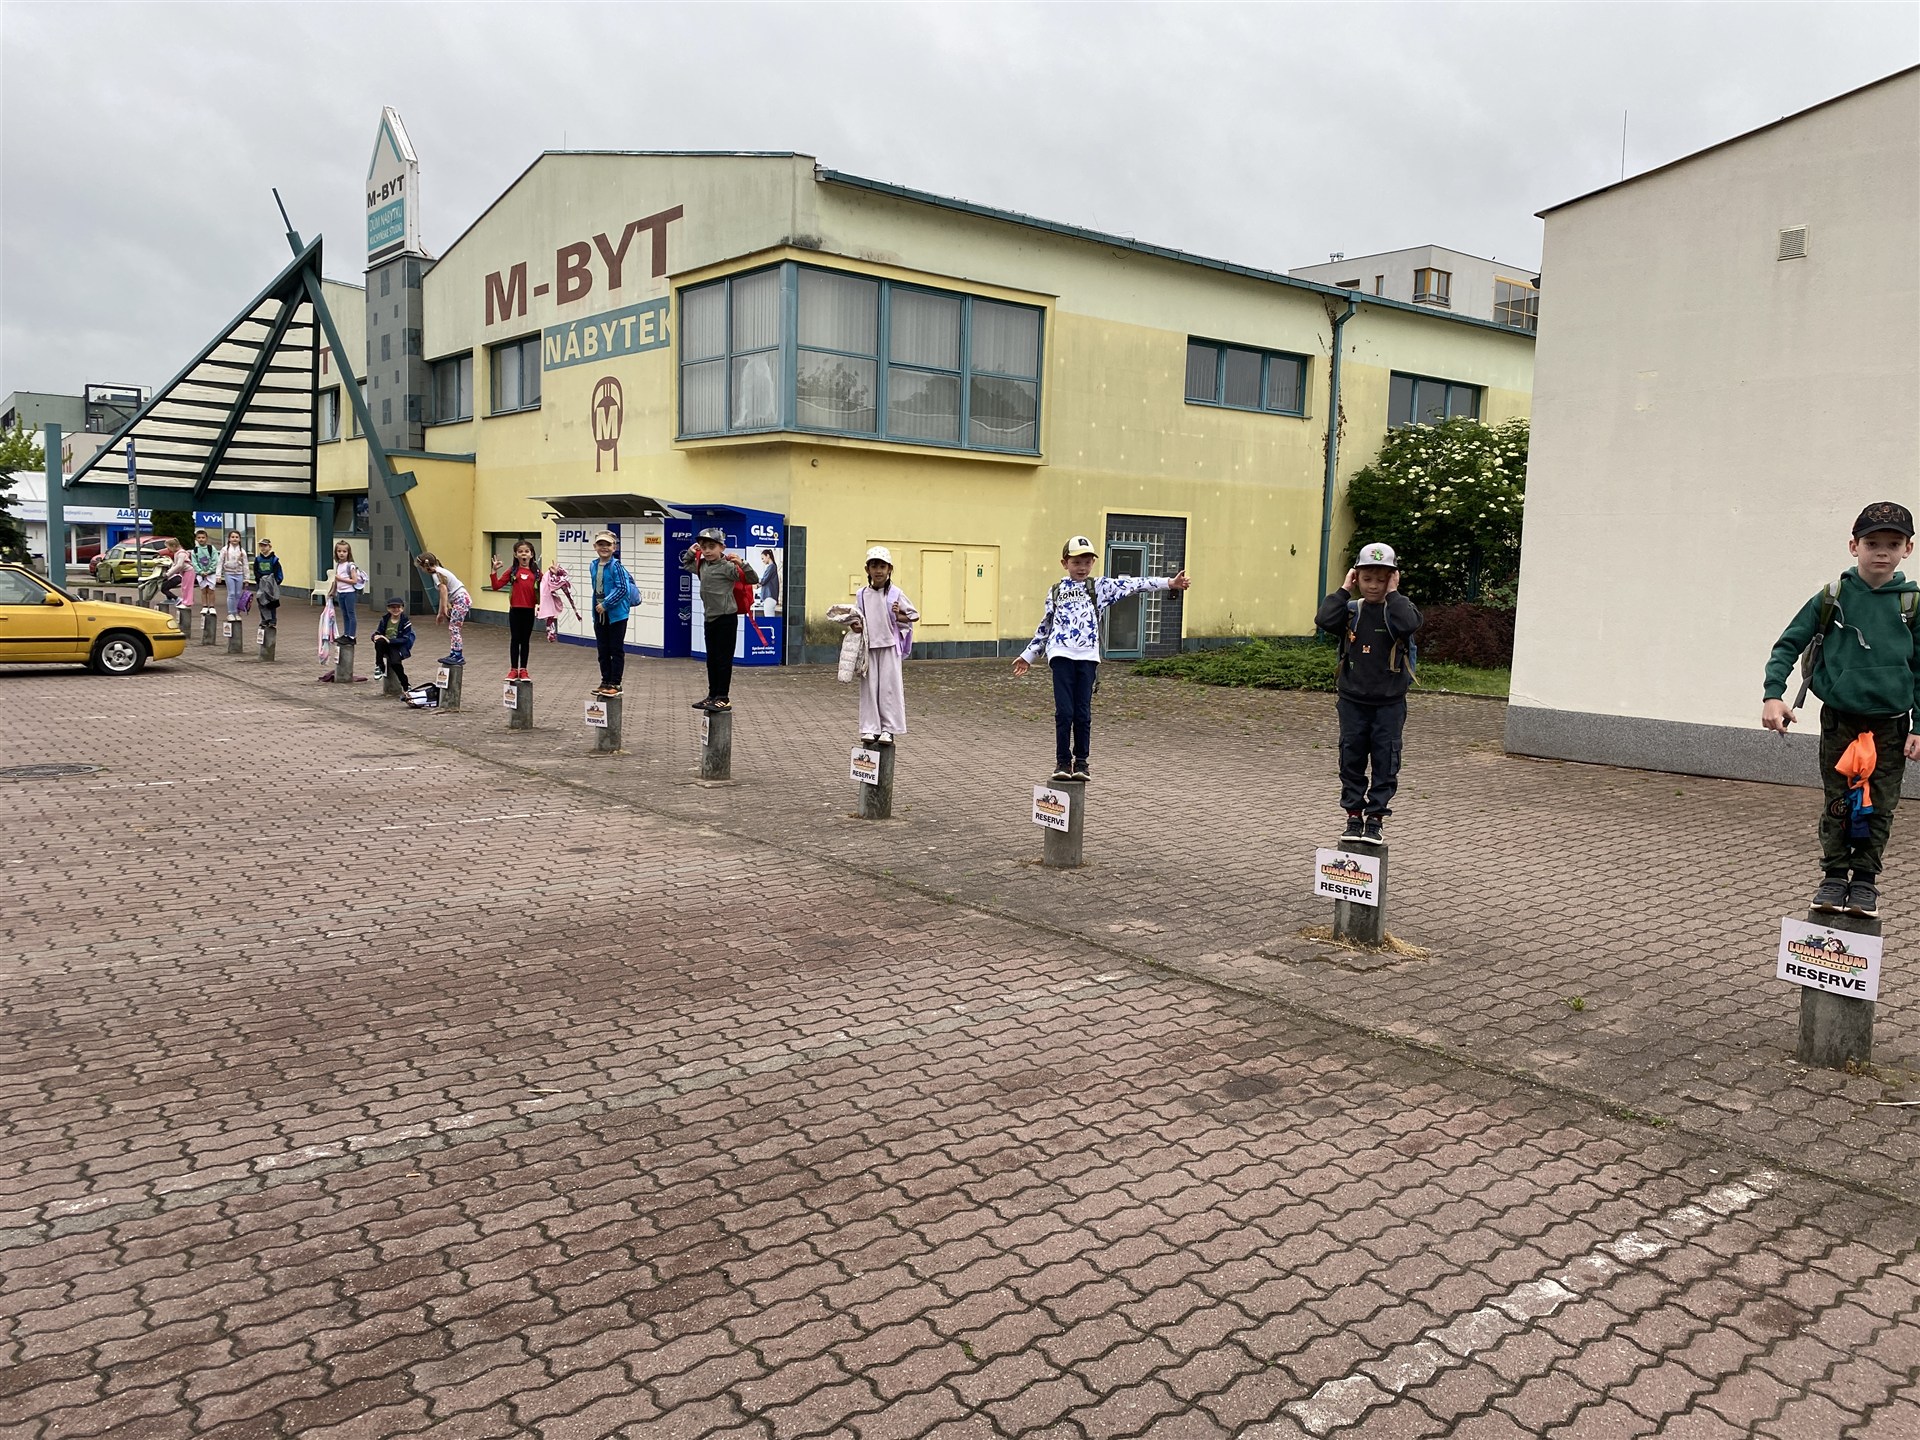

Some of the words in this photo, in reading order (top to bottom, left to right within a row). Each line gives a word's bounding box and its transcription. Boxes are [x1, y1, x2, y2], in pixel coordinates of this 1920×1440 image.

[368, 174, 404, 208] M-BYT
[485, 204, 684, 327] M-BYT
[545, 308, 670, 365] NÁBYTEK
[117, 509, 135, 517] AAA
[138, 510, 152, 518] AU
[751, 525, 774, 537] GLS
[1058, 590, 1084, 601] SONIC
[852, 770, 876, 781] RESERVE
[1035, 812, 1065, 827] RESERVE
[1321, 864, 1373, 883] LUMPARIUM
[1320, 882, 1372, 899] RESERVE
[1788, 941, 1868, 969] LUMPARIUM
[1785, 963, 1867, 991] RESERVE
